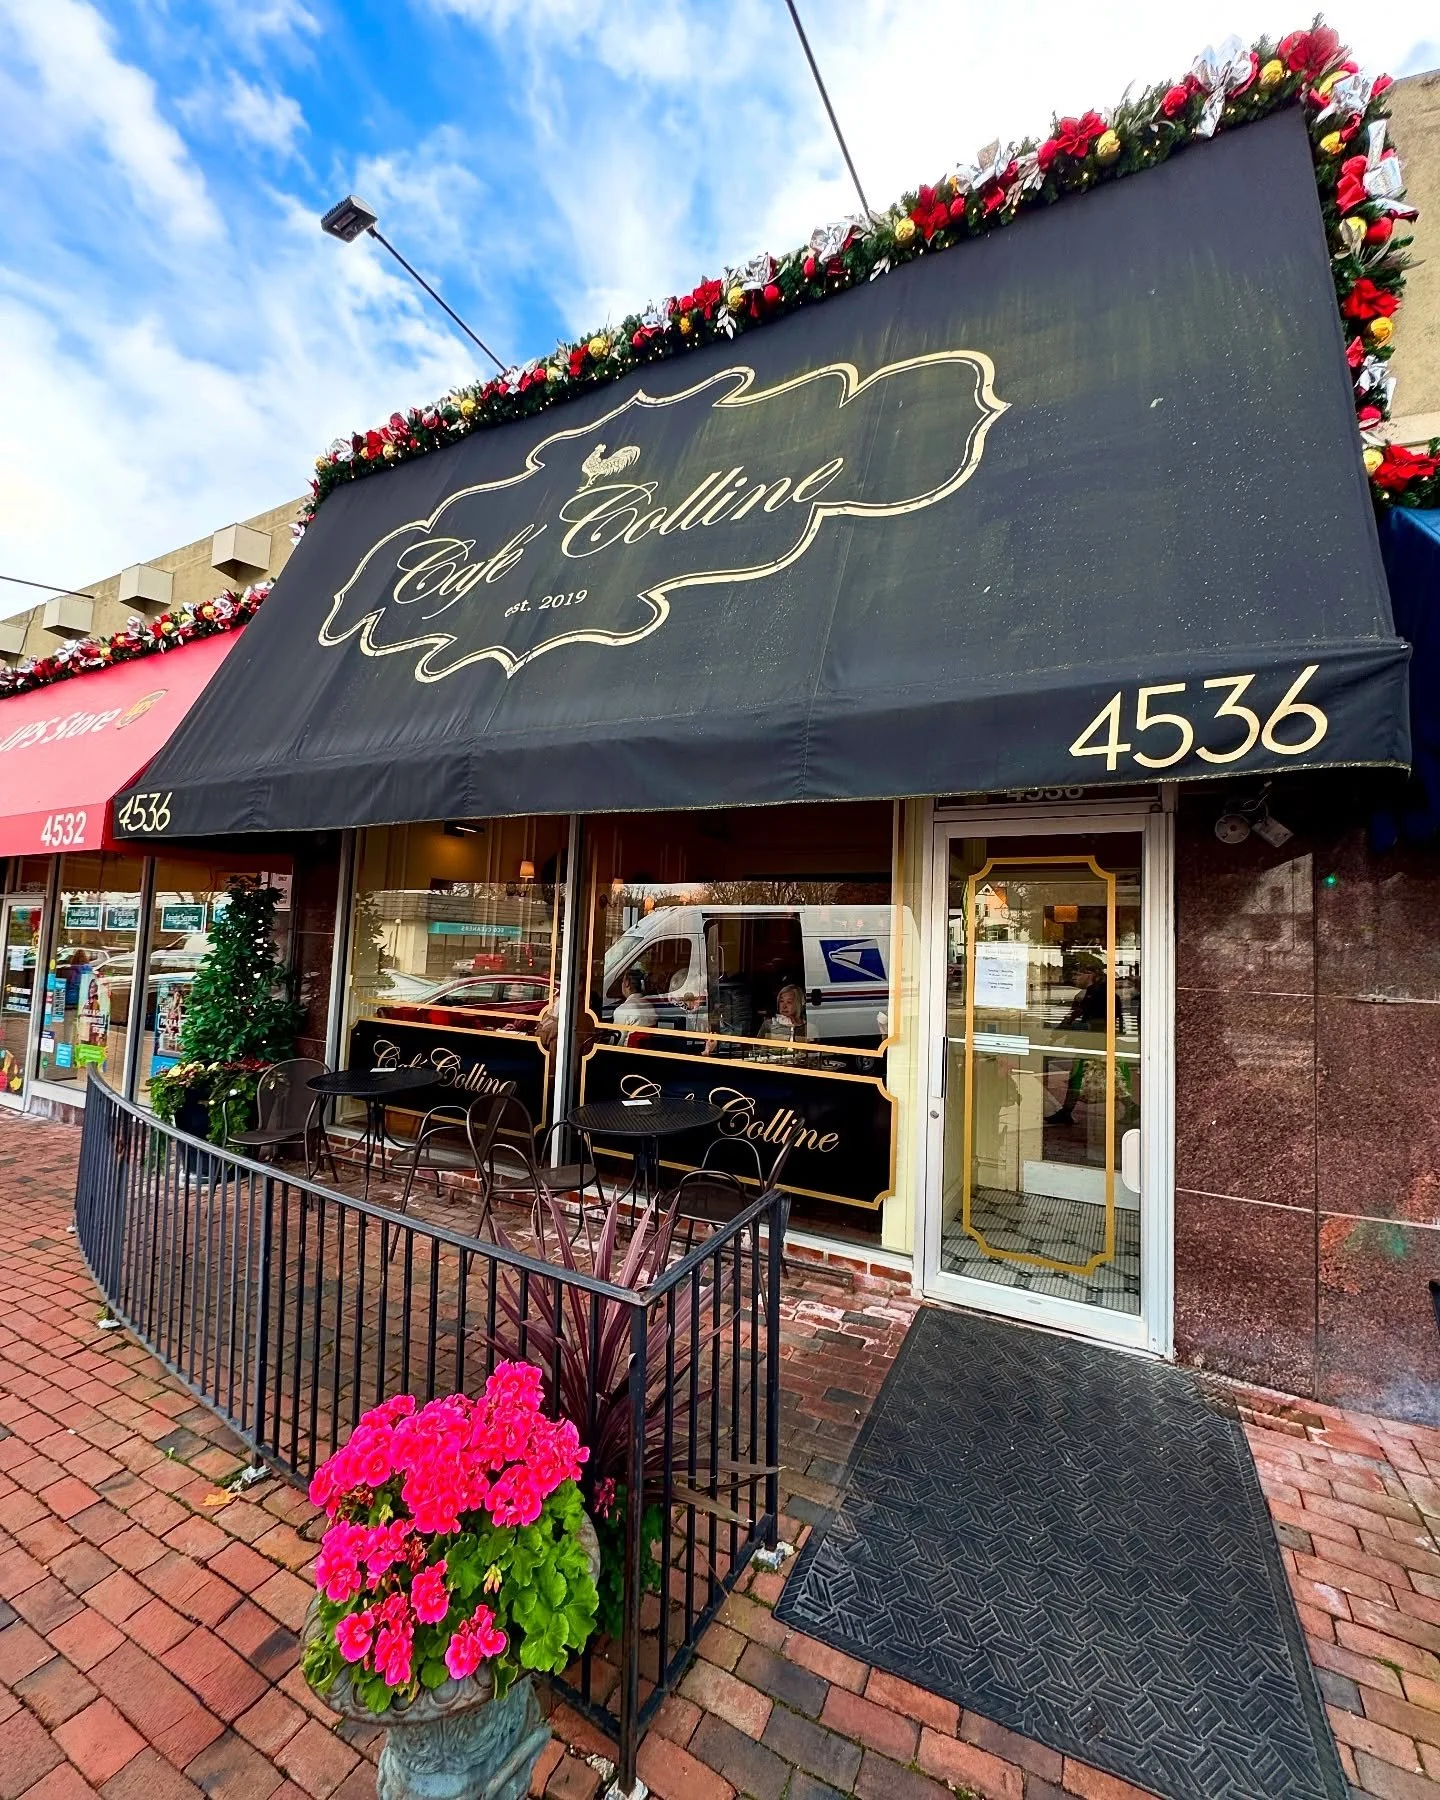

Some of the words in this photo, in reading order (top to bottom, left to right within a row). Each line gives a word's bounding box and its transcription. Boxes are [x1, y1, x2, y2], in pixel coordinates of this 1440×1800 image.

[393, 524, 547, 620] Café
[560, 458, 843, 558] Colline
[504, 600, 532, 618] est.
[541, 589, 588, 610] 2019
[40, 708, 122, 744] Store
[1068, 664, 1329, 771] 4536
[40, 811, 87, 847] 4532
[118, 791, 173, 832] 4536
[708, 1086, 840, 1152] Colline
